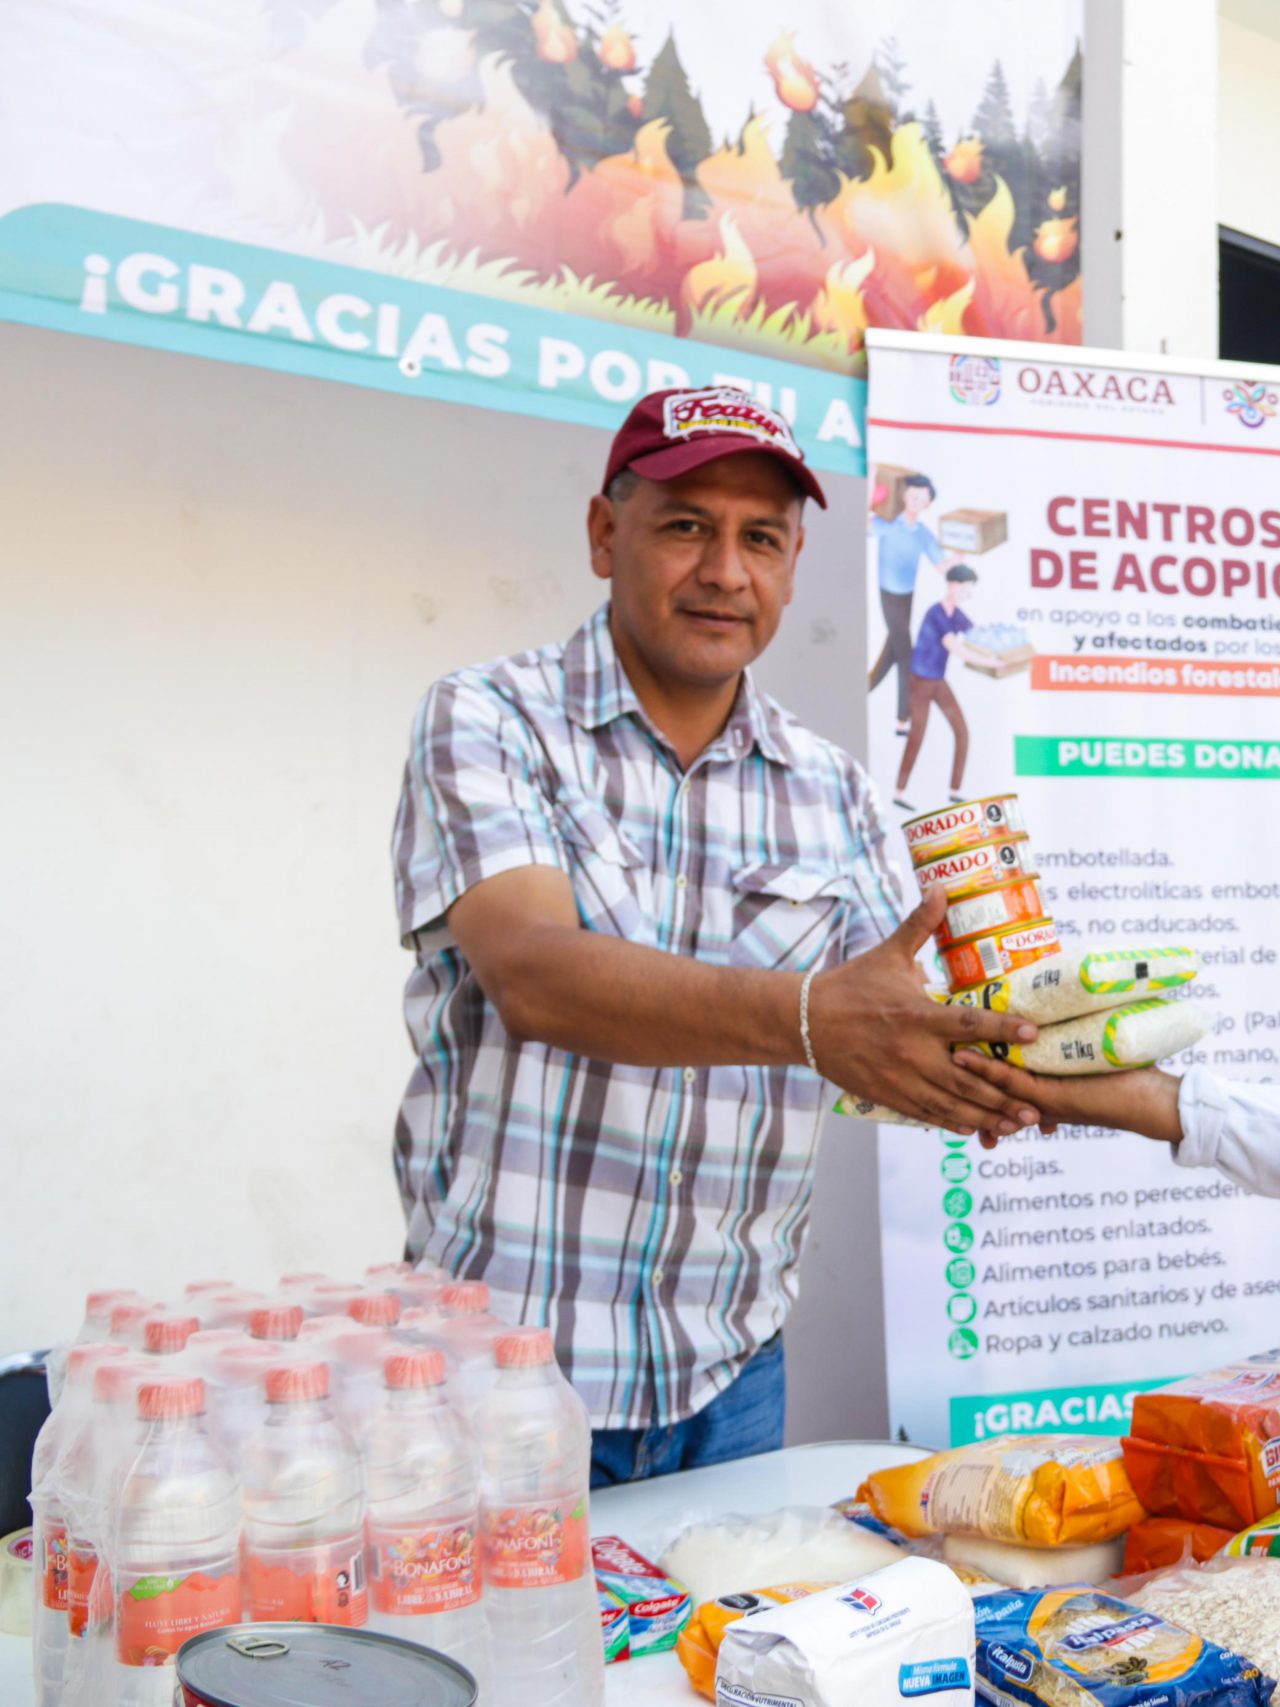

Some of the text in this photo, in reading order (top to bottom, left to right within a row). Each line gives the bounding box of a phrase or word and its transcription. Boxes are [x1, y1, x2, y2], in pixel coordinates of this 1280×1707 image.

[79, 253, 511, 378] ¡GRACIAS
[714, 373, 798, 426] U
[817, 399, 867, 449] A
[1017, 367, 1177, 406] OAXACA
[1028, 548, 1099, 591] DE
[1017, 607, 1044, 623] en
[1049, 607, 1123, 631] apoyo
[1126, 611, 1141, 626] a
[1147, 608, 1177, 628] los
[1073, 635, 1086, 653] y
[1090, 631, 1207, 654] afectados
[1214, 638, 1249, 660] por
[1049, 661, 1177, 687] Incendios
[1058, 741, 1186, 768] PUEDES
[1034, 848, 1173, 868] embotellada.
[1067, 880, 1202, 902] electrolíticas
[1088, 917, 1115, 935] no
[1122, 912, 1240, 936] caducados.
[1197, 946, 1245, 965] erial
[1250, 946, 1277, 965] de
[1212, 1012, 1236, 1036] jo
[1074, 1040, 1095, 1061] 1kg
[1181, 1047, 1207, 1067] de
[1213, 1048, 1279, 1067] mano,
[978, 1156, 1064, 1182] Cobijas.
[980, 1187, 1094, 1215] Alimentos
[1101, 1190, 1128, 1208] no
[981, 1216, 1213, 1249] Alimentos enlatados.
[982, 1248, 1227, 1285] Alimentos para bebés.
[984, 1291, 1081, 1319] Artículos
[1087, 1285, 1188, 1313] sanitarios
[1194, 1289, 1206, 1305] y
[1212, 1281, 1237, 1300] de
[986, 1317, 1228, 1358] Ropa y calzado nuevo.
[394, 1554, 473, 1577] BONAFONT
[634, 1596, 680, 1614] Colgate
[991, 1644, 1029, 1675] Italpasta
[902, 1671, 966, 1690] NUEVA IMAGEN
